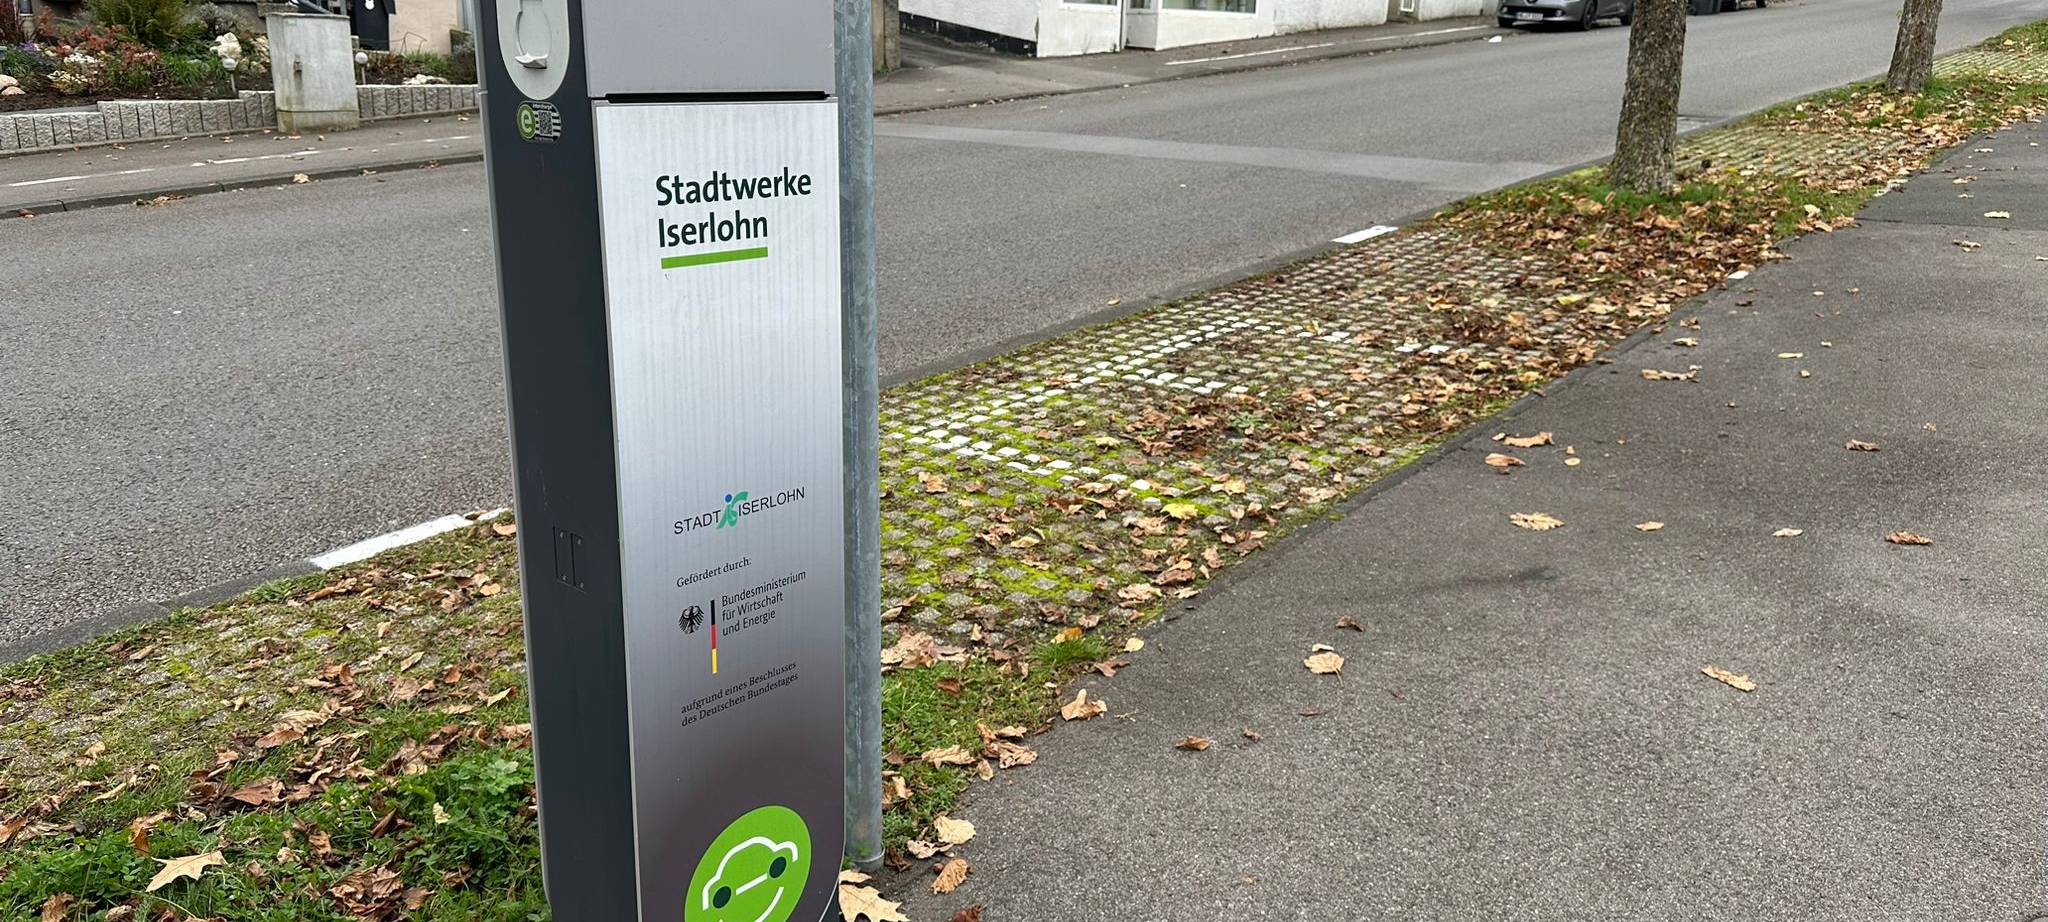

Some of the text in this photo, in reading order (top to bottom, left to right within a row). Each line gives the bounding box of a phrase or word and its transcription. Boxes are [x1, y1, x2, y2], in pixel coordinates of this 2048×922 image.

[656, 167, 812, 206] Stadtwerke
[658, 210, 768, 248] Iserlohn
[674, 487, 805, 535] STADT ISERLOHN
[676, 557, 752, 588] Gefördert durch:
[722, 570, 806, 607] Bundesministerium
[722, 591, 784, 622] für Wirtschaft
[722, 609, 776, 636] und Energie
[681, 661, 797, 714] aufgrund eines Beschlusses
[681, 672, 799, 727] des Deutschen Bundestages
